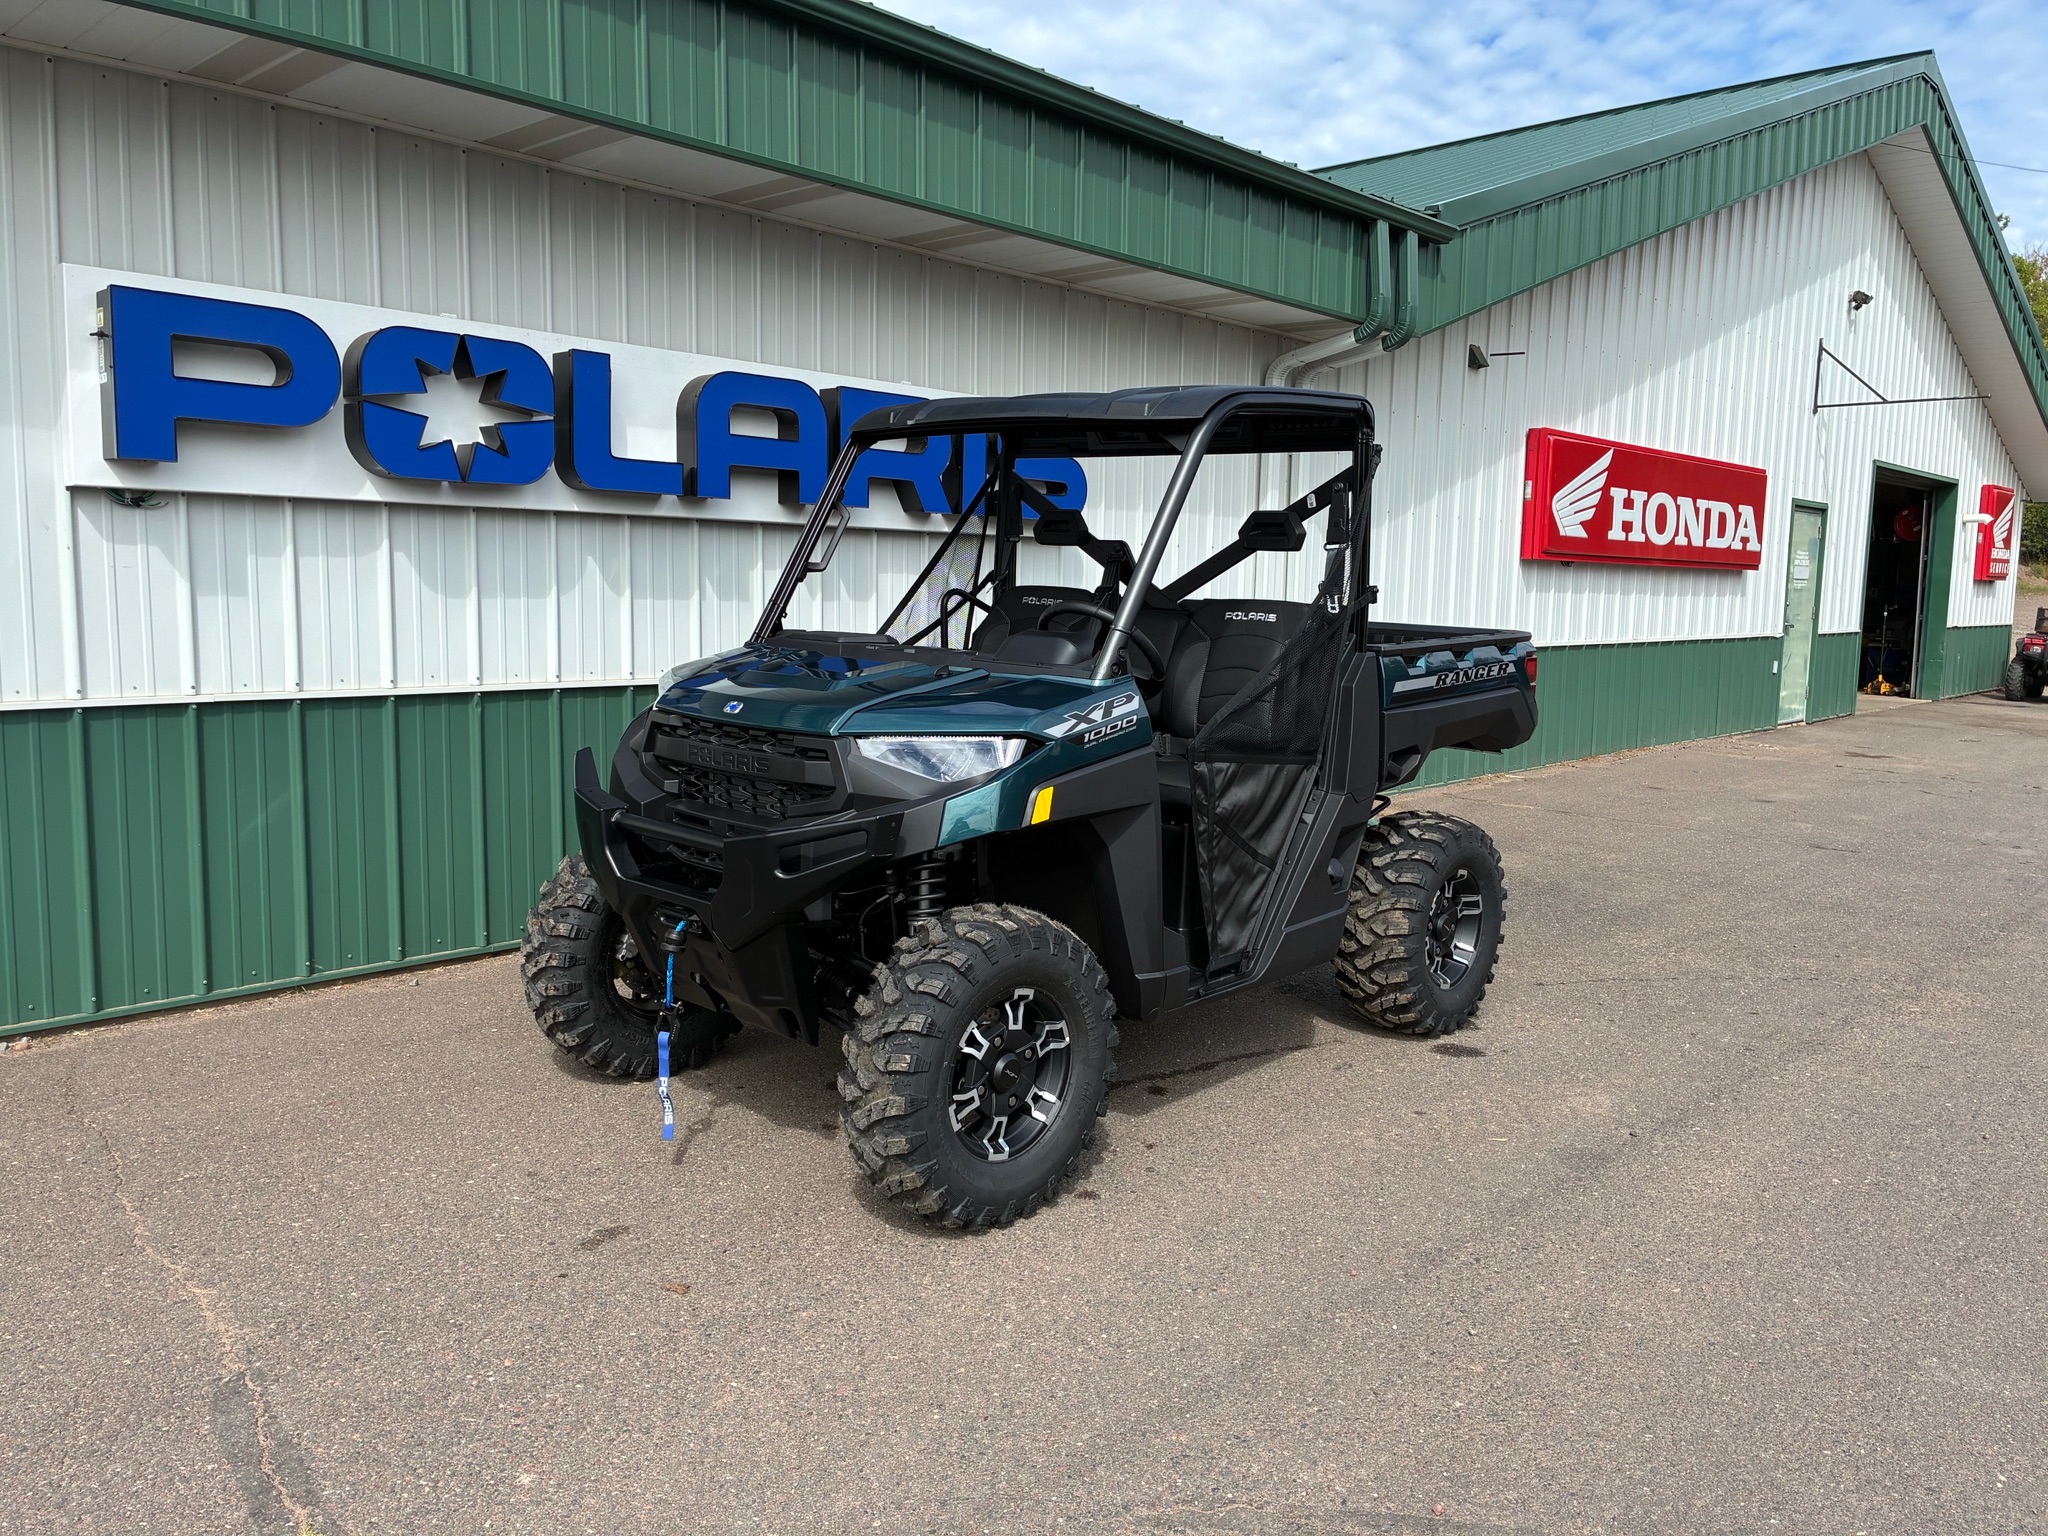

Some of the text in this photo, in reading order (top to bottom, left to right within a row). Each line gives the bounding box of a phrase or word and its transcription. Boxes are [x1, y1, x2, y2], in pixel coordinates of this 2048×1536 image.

[1608, 487, 1761, 552] HONDA
[1991, 548, 2010, 559] HONDA
[1224, 611, 1277, 622] POLARIS
[1434, 662, 1510, 689] RANGER
[1061, 691, 1136, 736] XP
[1084, 715, 1137, 742] 1000
[687, 744, 770, 775] POLARIS
[659, 1076, 673, 1125] POARIS
